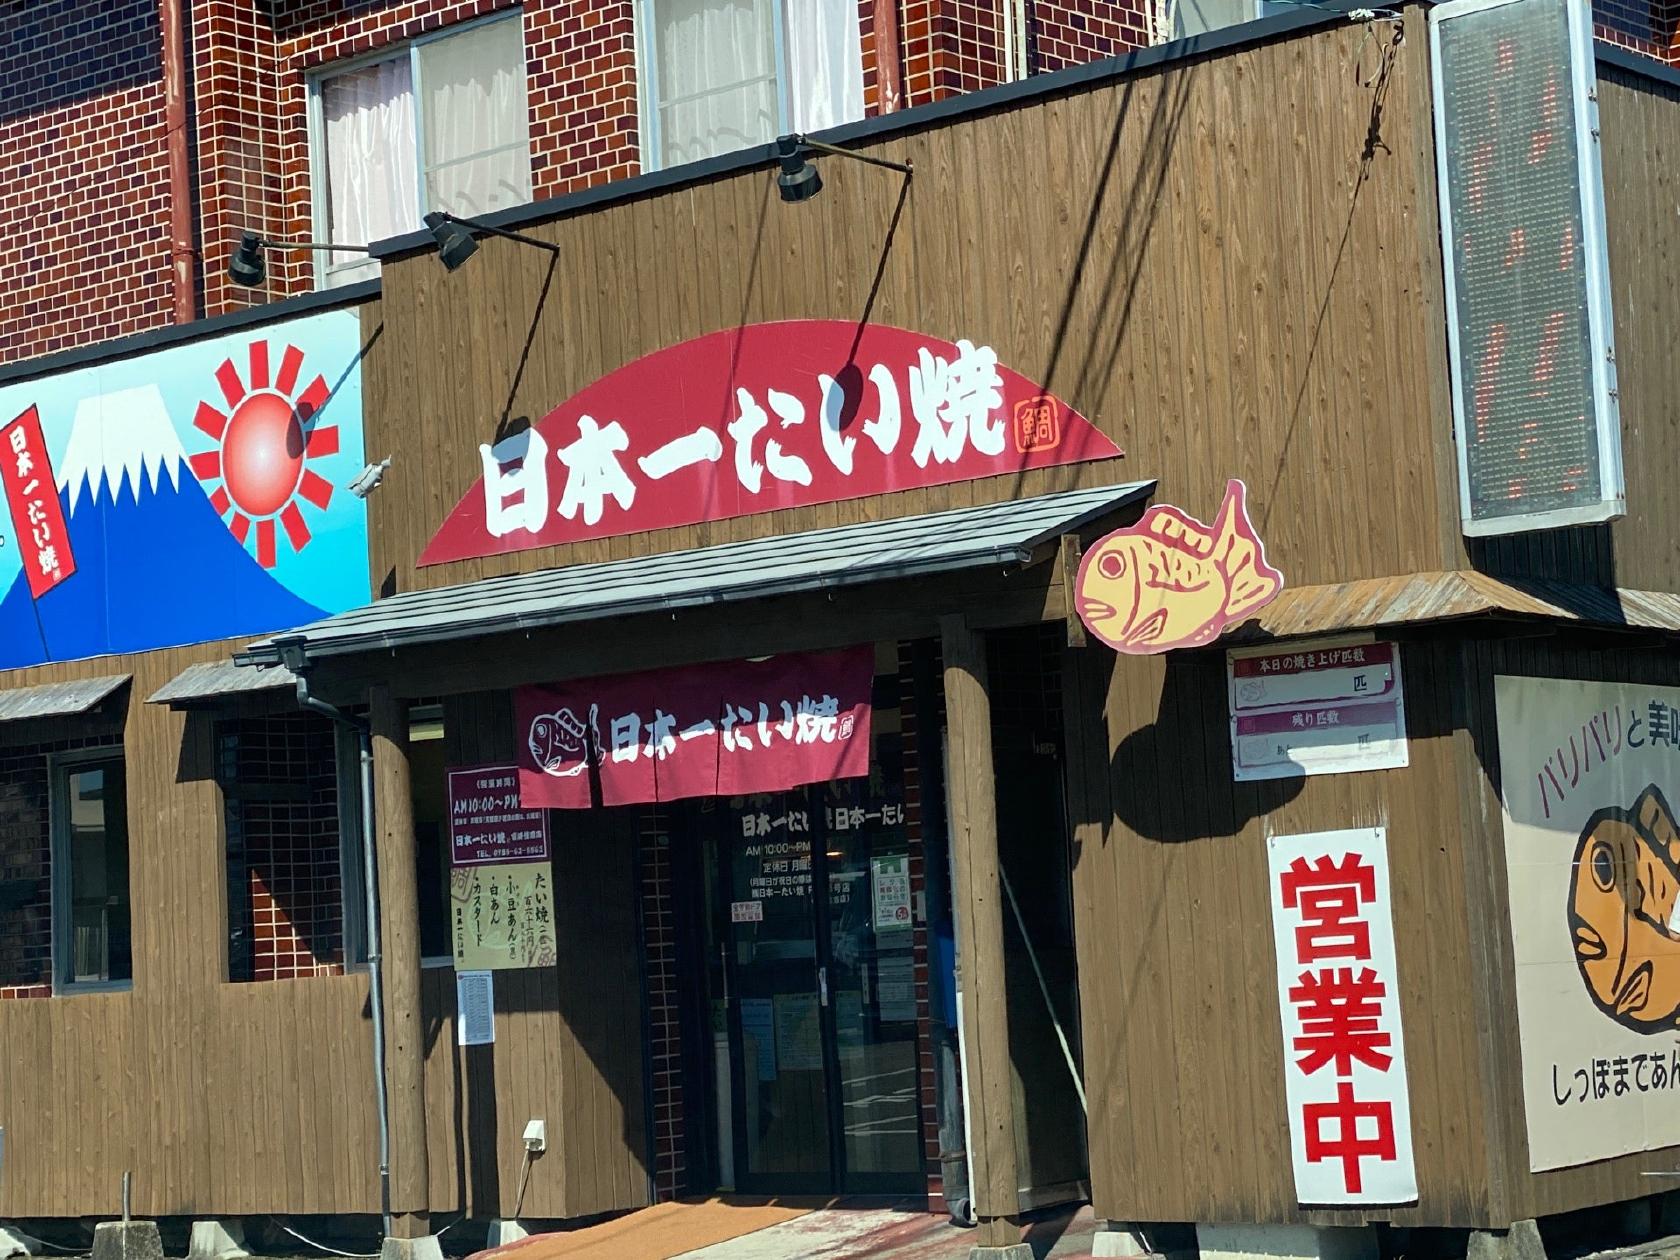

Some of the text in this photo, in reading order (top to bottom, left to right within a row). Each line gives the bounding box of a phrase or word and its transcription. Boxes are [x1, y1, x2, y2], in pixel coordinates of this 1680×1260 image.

[479, 339, 1006, 535] 日本一たい焼
[1018, 402, 1056, 449] 鯛
[9, 425, 59, 575] 日本一たい焼
[1259, 650, 1366, 672] 本日の焼き上げ匹数
[1354, 675, 1367, 691] 匹
[610, 694, 839, 763] 日本一たい焼
[1292, 713, 1340, 727] 残り匹数
[745, 846, 761, 857] AM
[1280, 852, 1396, 1194] 営業中
